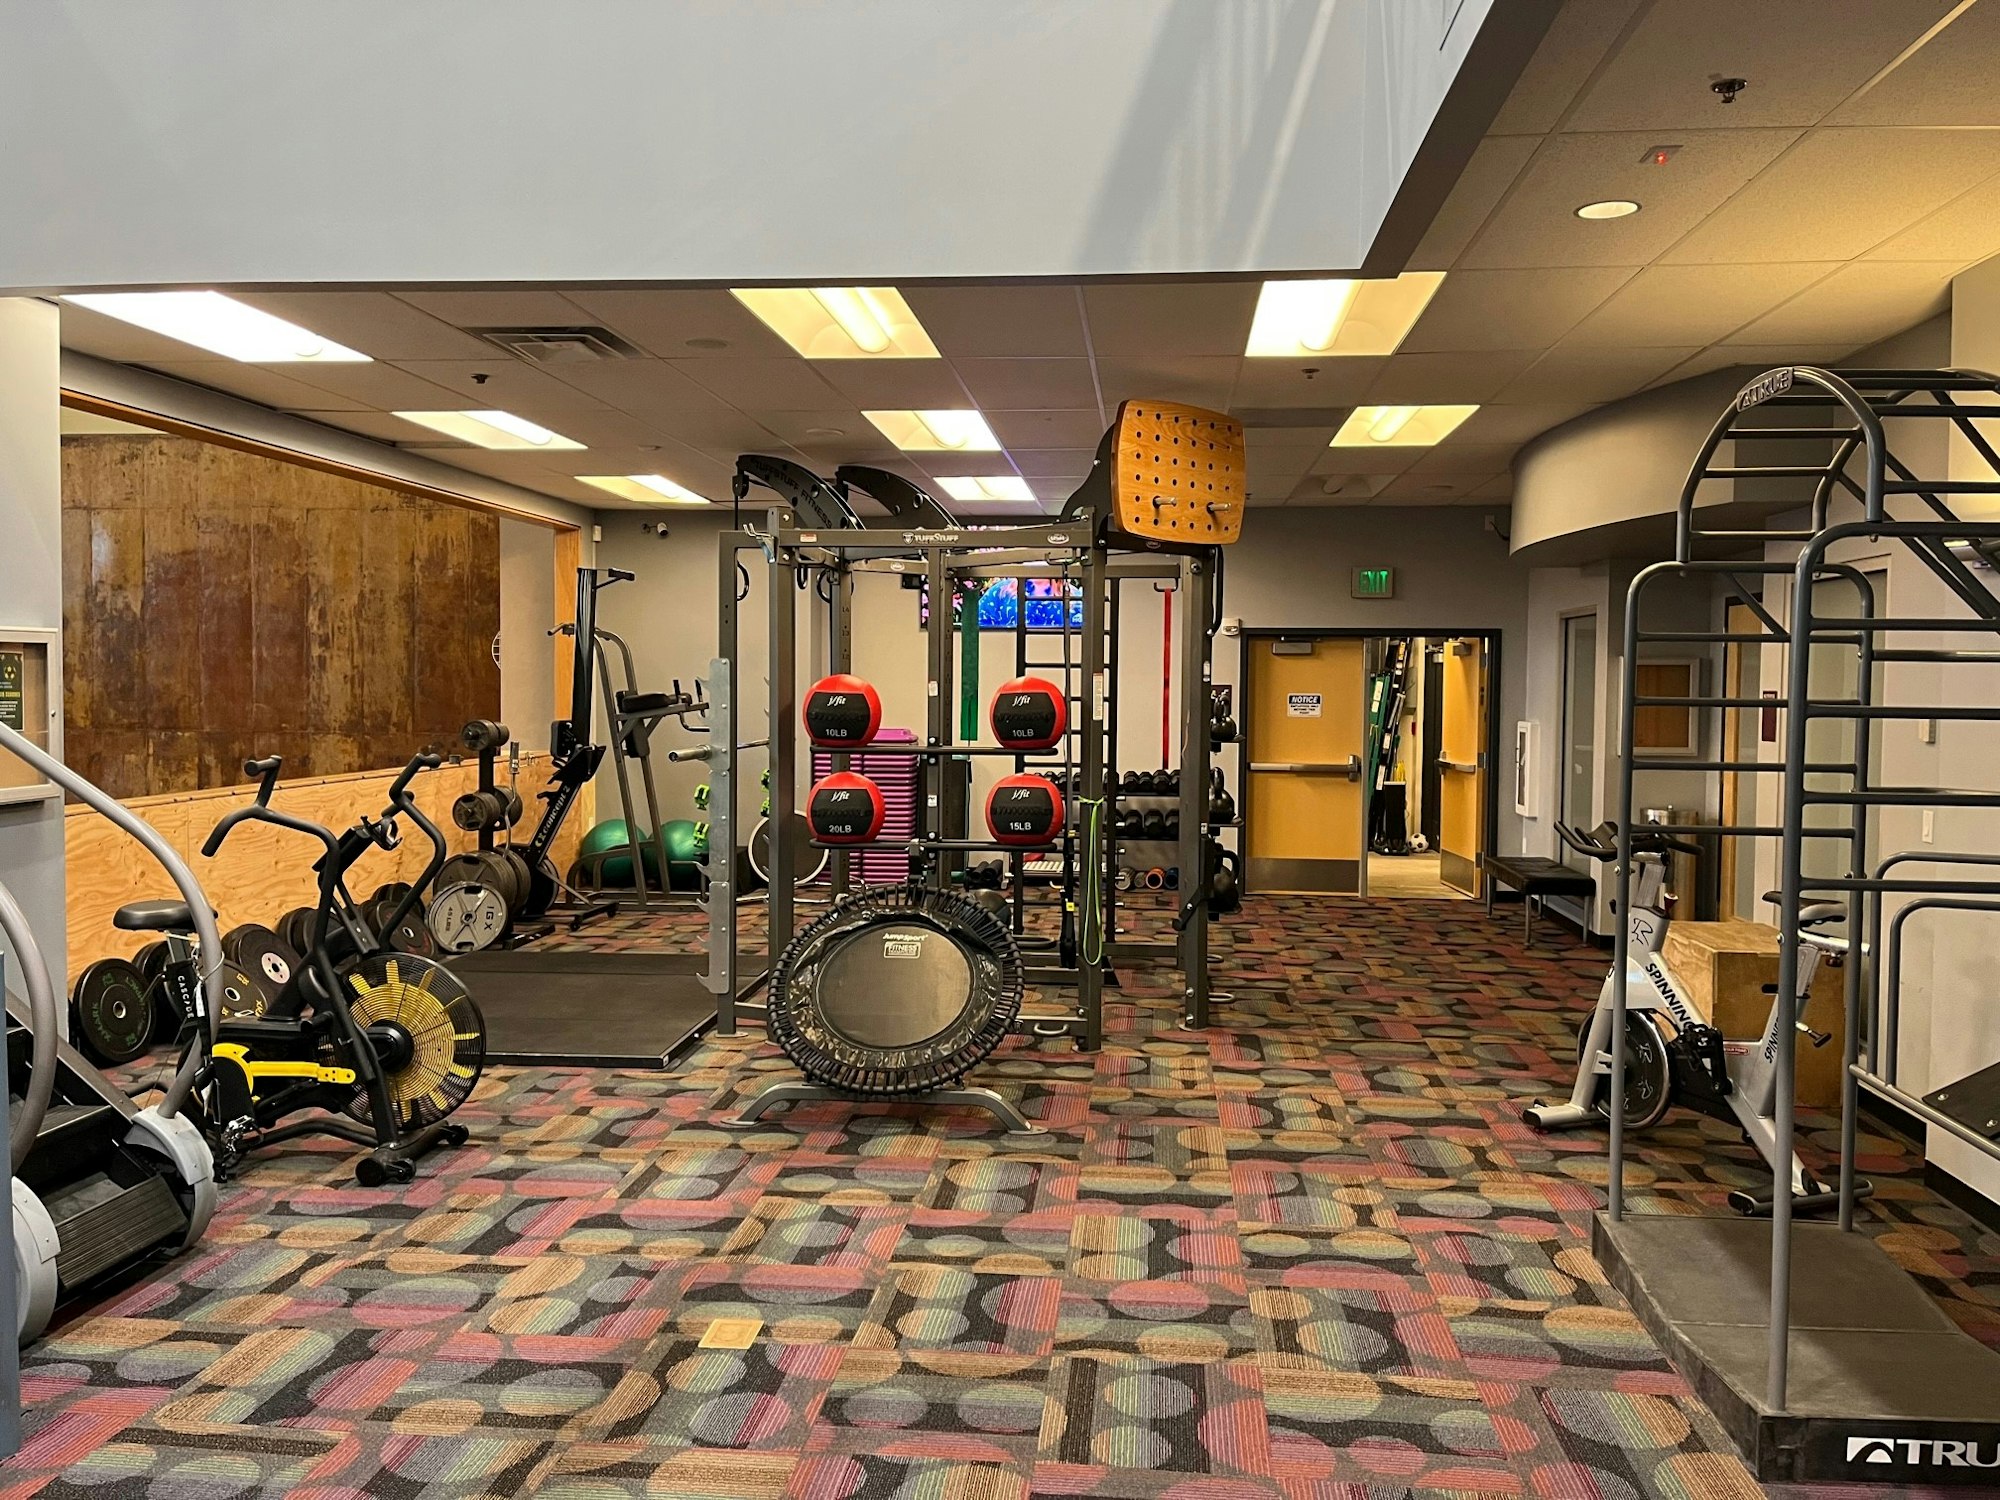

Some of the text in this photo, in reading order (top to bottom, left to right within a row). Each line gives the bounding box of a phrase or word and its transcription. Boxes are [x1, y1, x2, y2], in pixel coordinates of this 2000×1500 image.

[801, 489, 833, 529] FITNESS
[1360, 570, 1388, 593] EXIT
[1291, 696, 1318, 704] NOTICE
[825, 728, 848, 737] 10LB
[1012, 728, 1034, 737] 10LB
[828, 824, 852, 833] 20LB
[1009, 822, 1032, 831] 15LB
[484, 905, 494, 931] IGX
